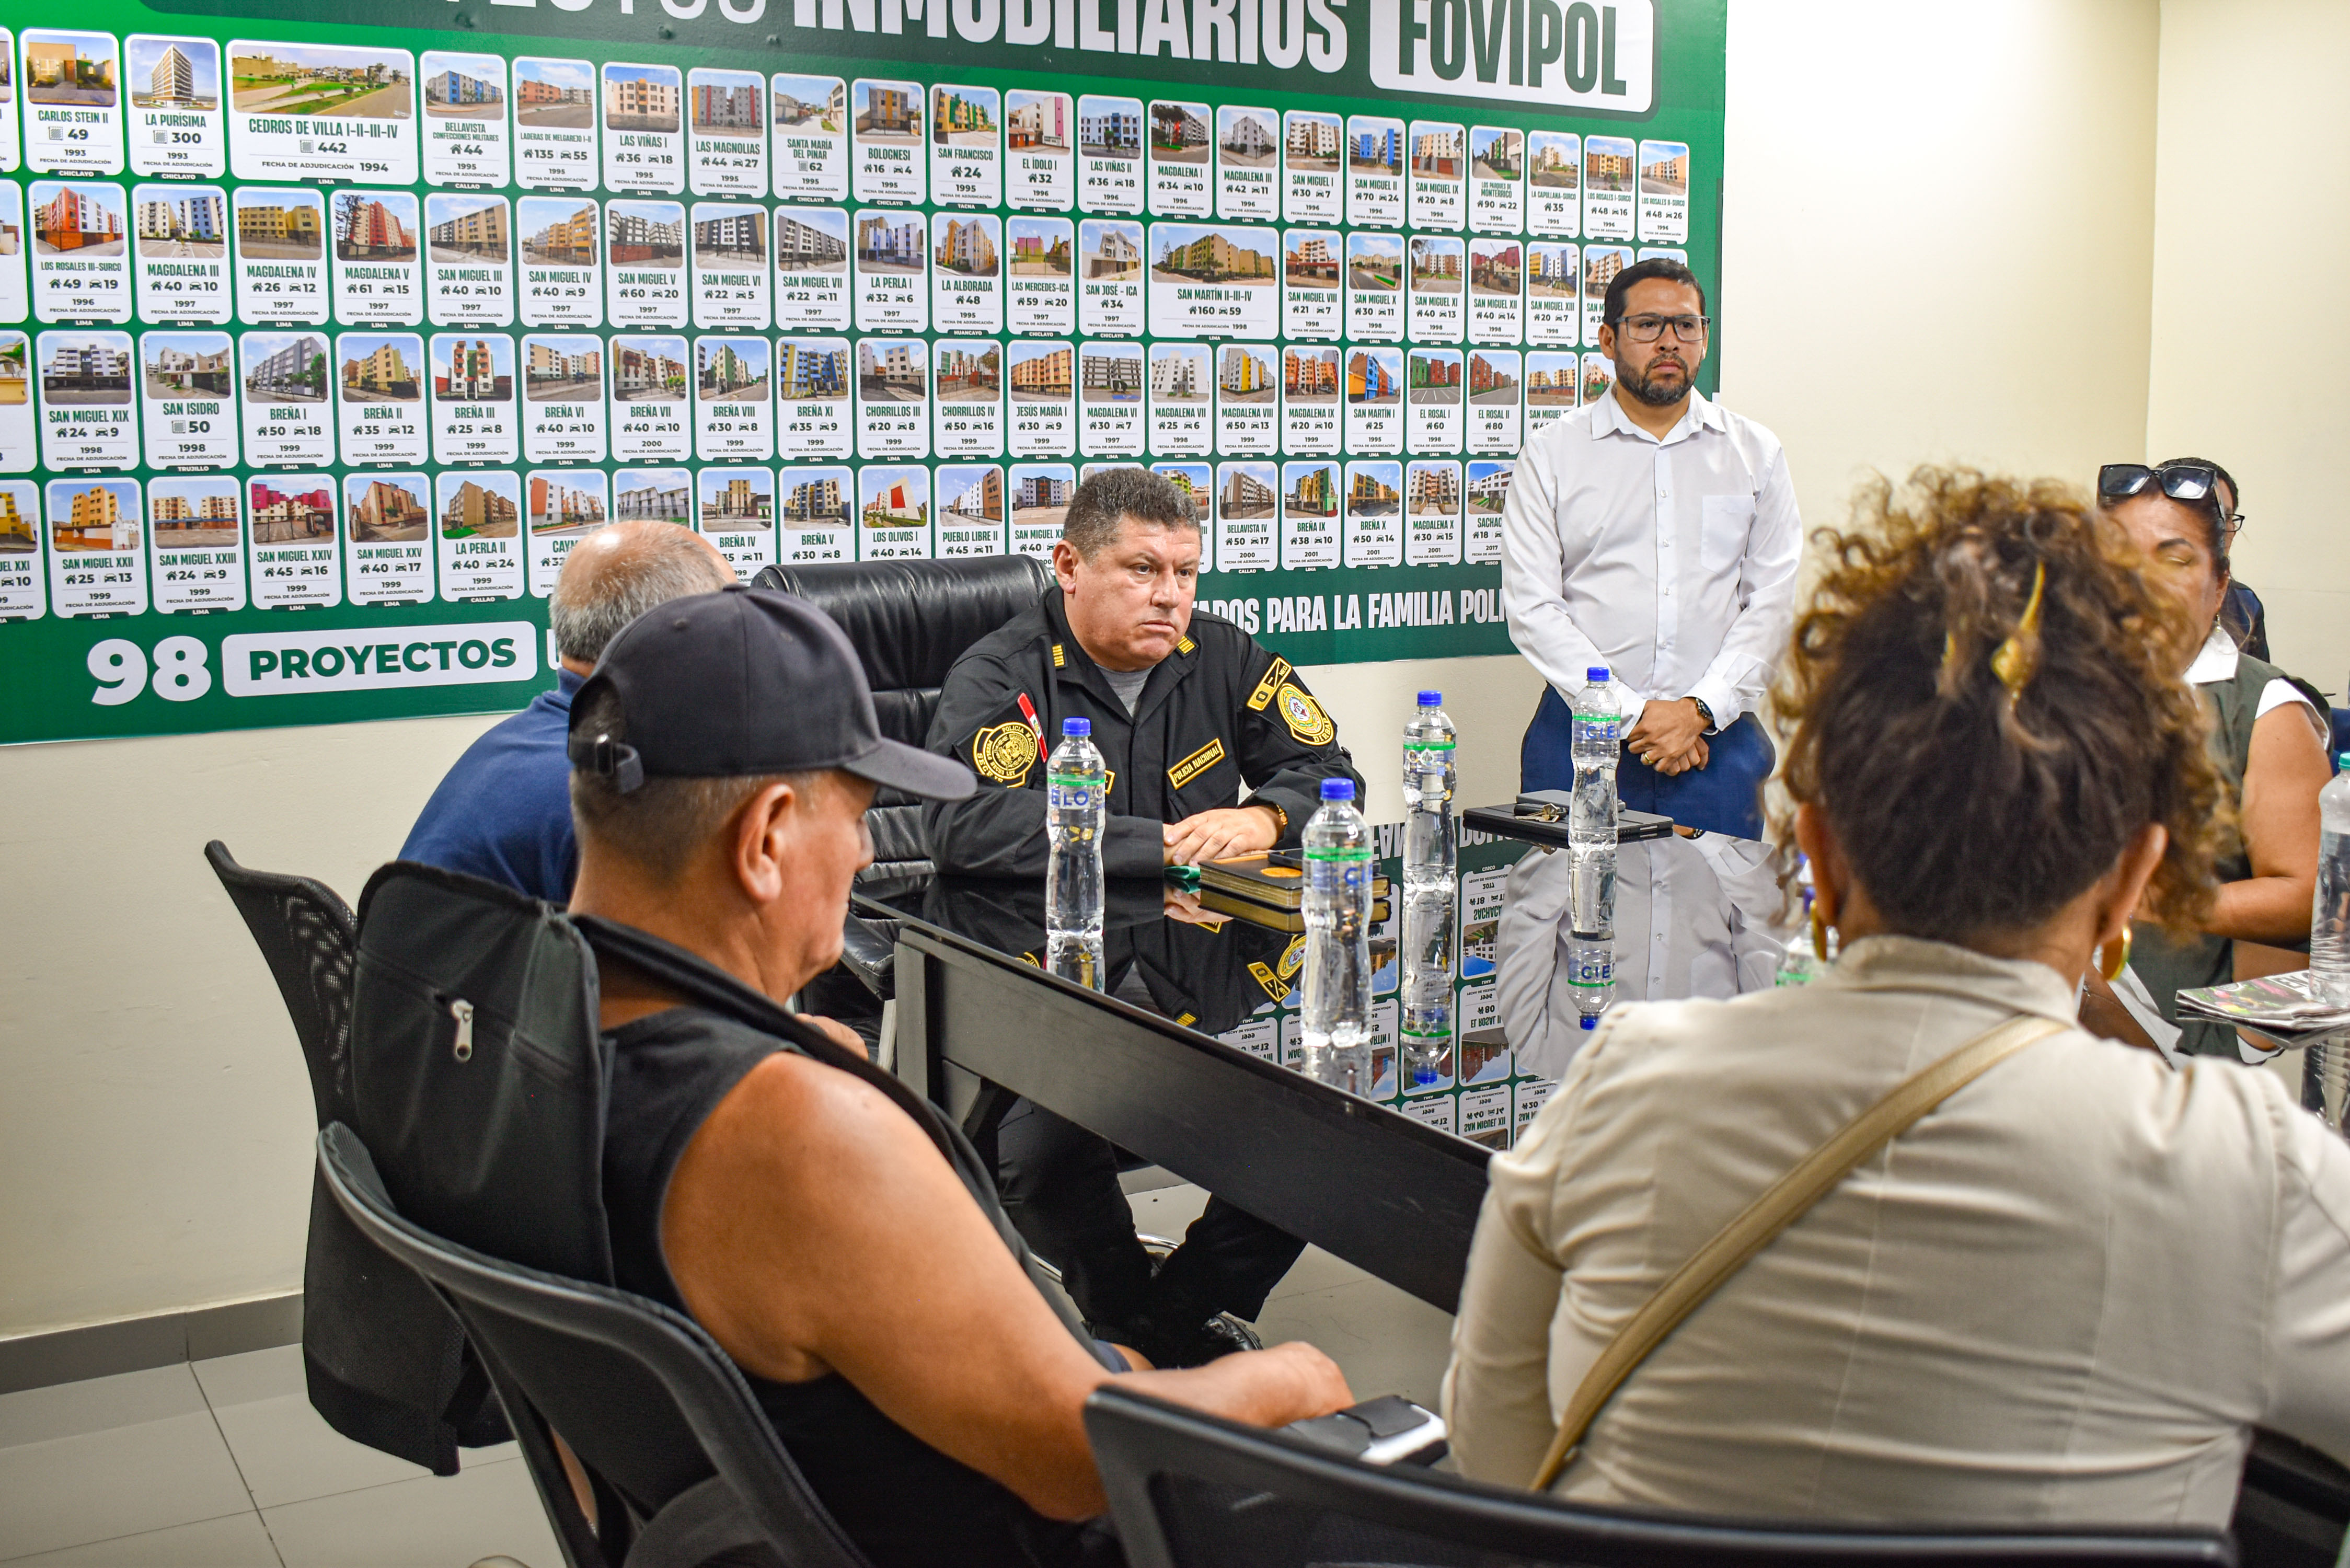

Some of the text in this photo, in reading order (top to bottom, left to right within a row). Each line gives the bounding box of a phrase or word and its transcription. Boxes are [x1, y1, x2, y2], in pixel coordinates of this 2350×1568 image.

[1399, 0, 1626, 96] FOVIPOL
[38, 110, 108, 123] CARLOS STEIN II
[249, 119, 292, 135] CEDROS
[296, 121, 309, 135] DE
[313, 121, 343, 136] VILLA
[445, 122, 486, 133] BELLAVISTA
[68, 129, 88, 140] 49
[318, 143, 347, 153] 442
[464, 145, 483, 155] 44
[535, 149, 587, 160] 135 55
[869, 148, 910, 160] BOLOGNESI
[360, 163, 388, 171] 1994
[874, 165, 884, 173] 16
[1158, 166, 1202, 178] MAGDALENA I
[1416, 182, 1458, 194] SAN MIGUEL IX
[1481, 189, 1512, 198] MONTERRICO
[41, 262, 121, 271] LOS ROSALES III-SURCO
[345, 268, 409, 280] MAGDALENA V
[63, 279, 118, 289] 49 19
[360, 284, 409, 294] 61 15
[1178, 289, 1192, 299] SAN
[1195, 287, 1222, 300] MARTÍN
[1415, 296, 1457, 306] SAN MIGUEL XI
[1199, 306, 1215, 315] 160
[163, 402, 219, 415] SAN ISIDRO
[364, 406, 402, 419] BREÑA II
[631, 405, 671, 417] BREÑA VII
[866, 406, 911, 417] CHORRILLOS
[1479, 410, 1509, 419] EL ROSAL II
[189, 421, 210, 433] 50
[365, 425, 414, 434] 35 12
[634, 423, 649, 432] 40
[1361, 520, 1386, 530] BREÑA X
[1478, 517, 1502, 528] SACHAC
[873, 532, 917, 542] LOS OLIVOS I
[456, 542, 505, 555] LA PERLA II
[63, 557, 133, 569] SAN MIGUEL XXII
[464, 559, 514, 569] 40 24
[78, 573, 132, 583] 25 13
[1268, 596, 1327, 633] PARA
[1334, 594, 1361, 629] LA
[1368, 591, 1454, 628] FAMILIA
[1460, 589, 1505, 624] POLI
[87, 636, 212, 705] 98
[249, 638, 516, 681] PROYECTOS
[1278, 666, 1288, 676] NEG
[1001, 725, 1034, 763] POLICIA NACIONAL
[1173, 746, 1219, 782] POLICIA NACIONAL
